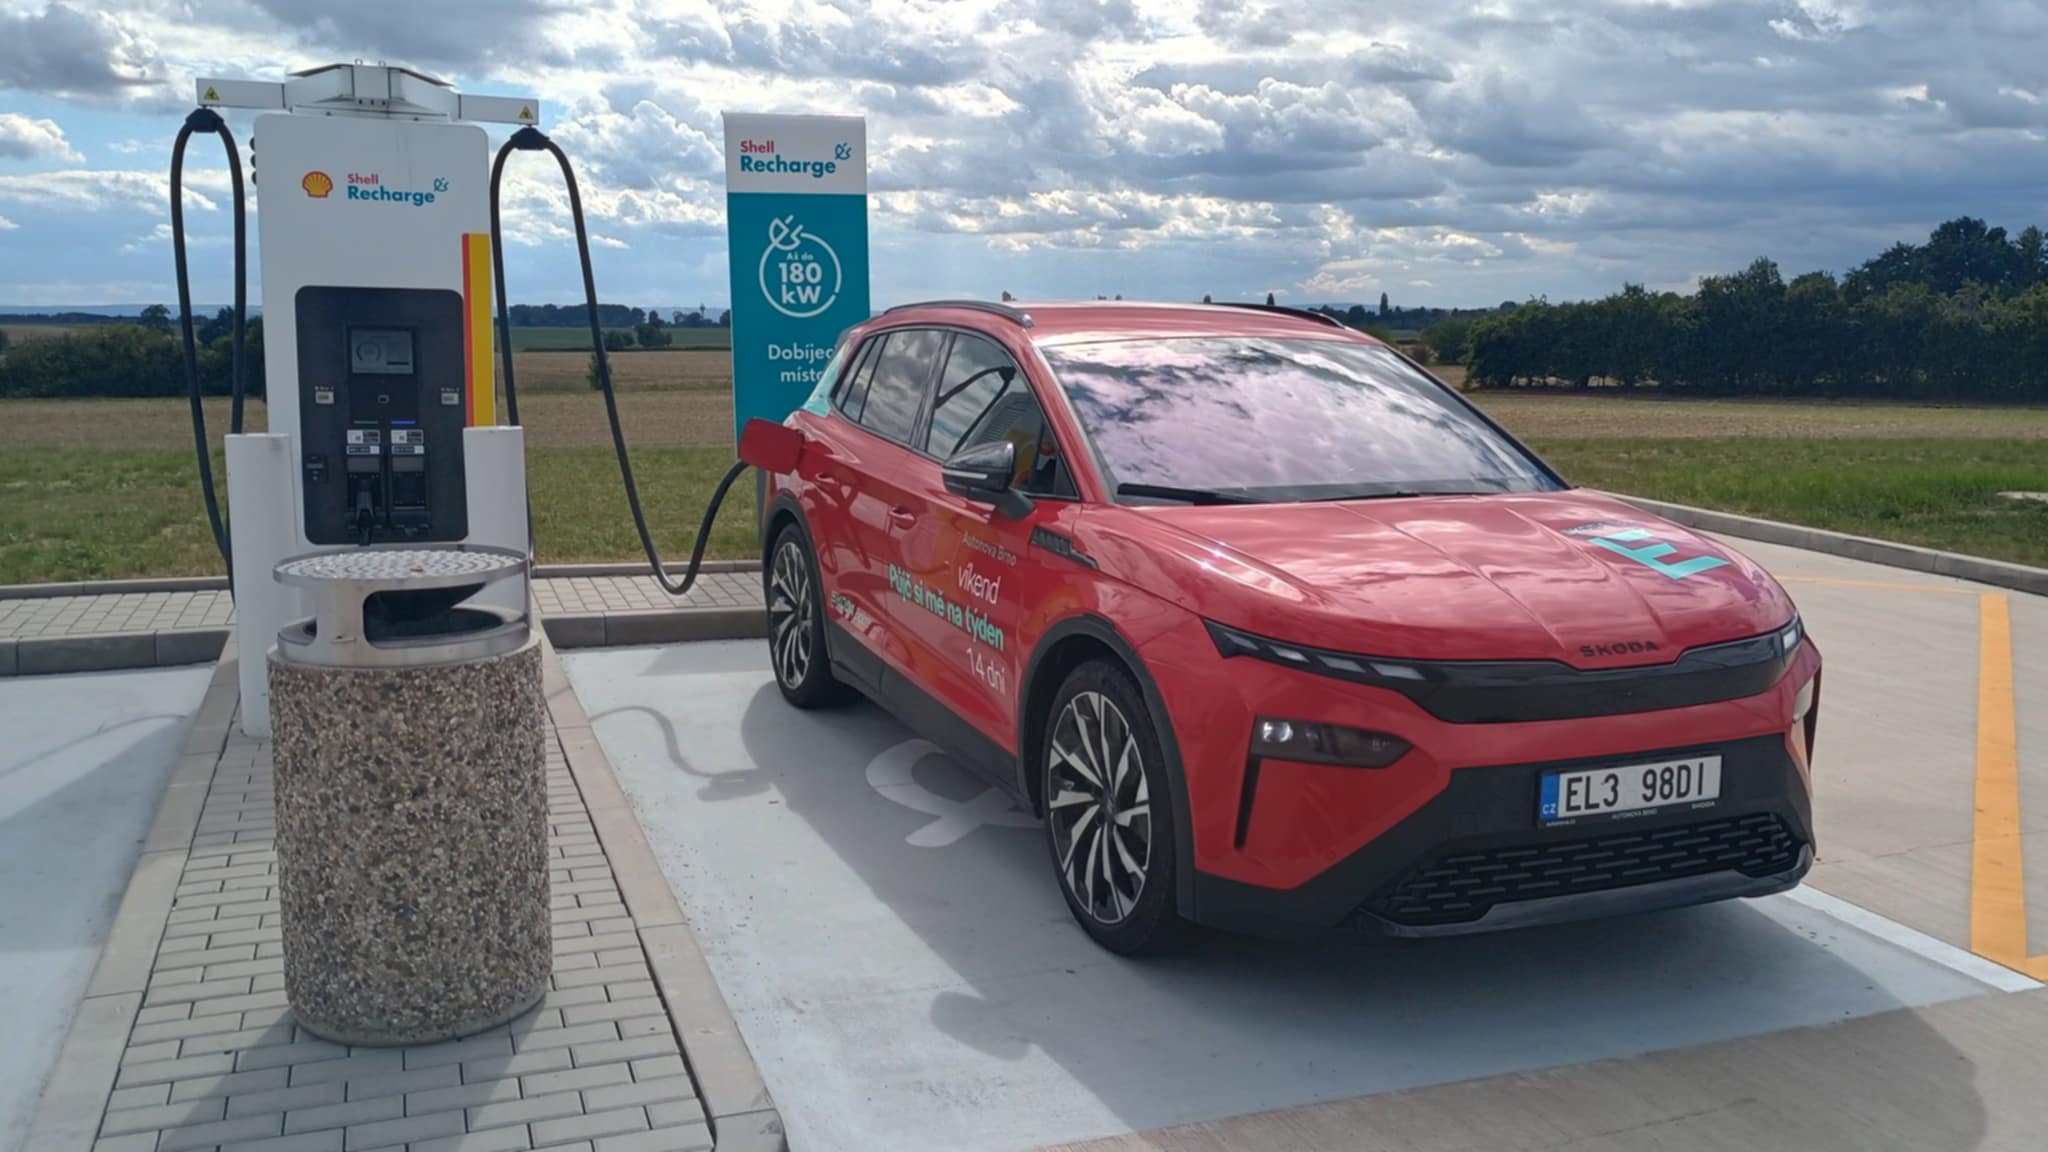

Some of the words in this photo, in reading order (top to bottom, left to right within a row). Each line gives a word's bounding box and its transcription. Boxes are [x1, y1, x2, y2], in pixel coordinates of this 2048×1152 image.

[740, 140, 775, 153] Shell
[740, 155, 836, 178] Recharge
[347, 173, 379, 185] Shell
[347, 185, 435, 207] Recharge
[779, 262, 822, 284] 180
[781, 285, 821, 305] kW
[768, 342, 835, 364] Dobíjec
[914, 580, 924, 603] si
[926, 590, 945, 617] mě
[947, 603, 963, 628] na
[965, 607, 1005, 652] týden
[966, 648, 985, 682] 14
[1565, 773, 1619, 812] EL3
[1642, 762, 1704, 802] 98DI
[1542, 803, 1557, 815] CZ
